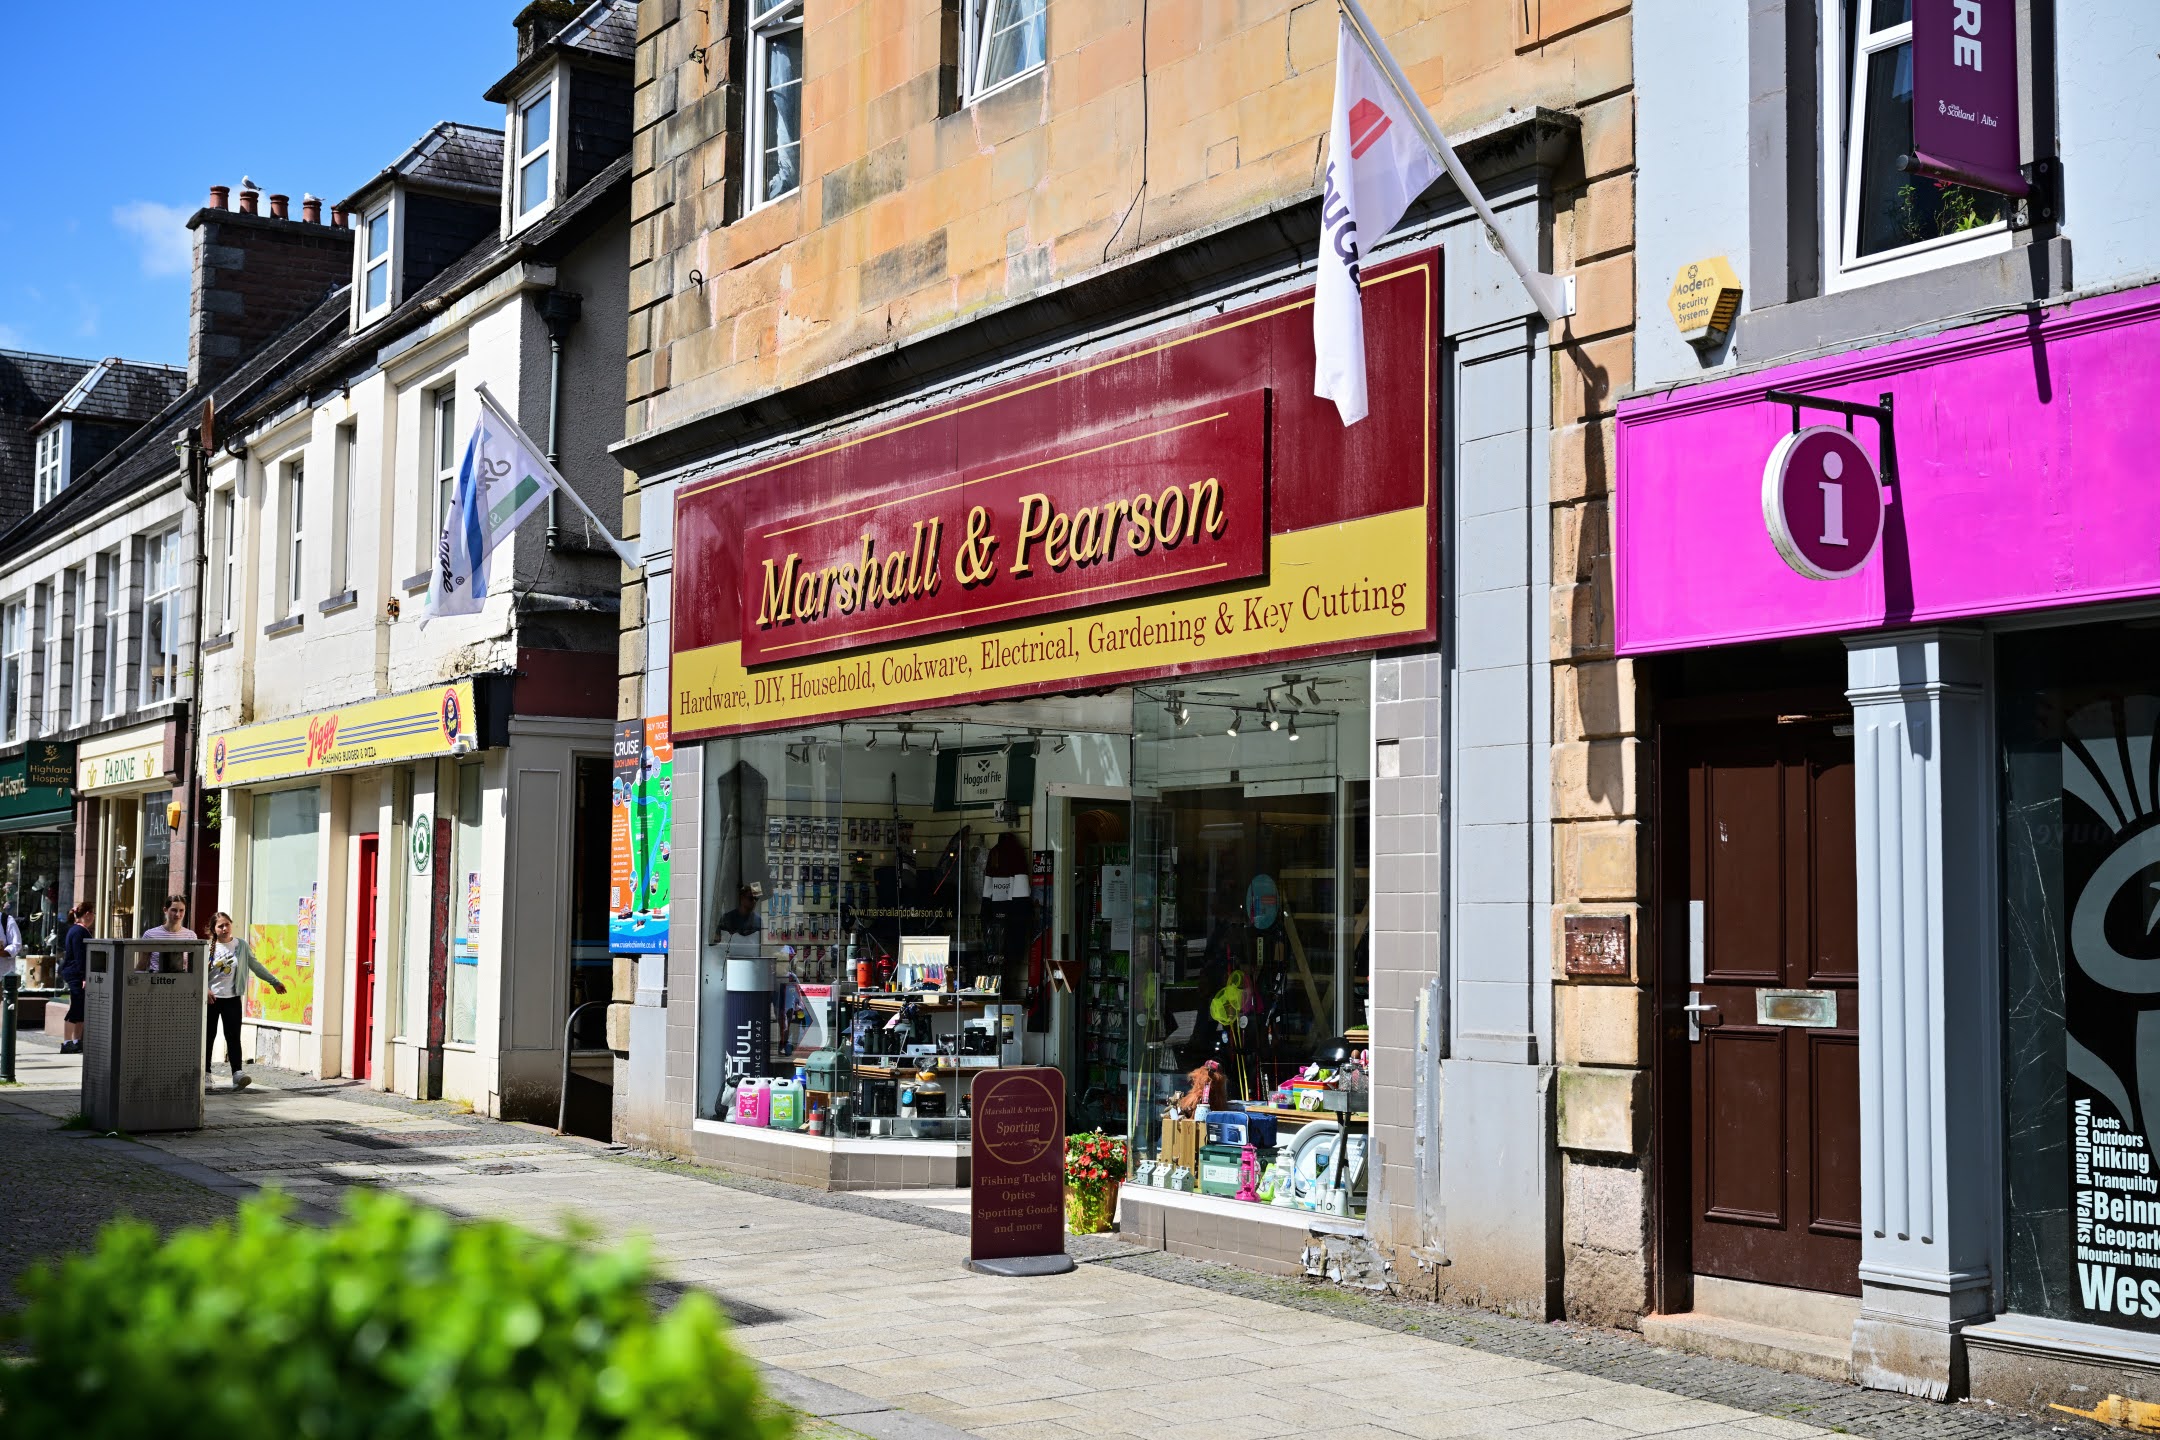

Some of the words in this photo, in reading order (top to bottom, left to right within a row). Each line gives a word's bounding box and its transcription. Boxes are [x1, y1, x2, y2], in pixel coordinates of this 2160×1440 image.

[1954, 0, 1982, 72] RE
[1947, 105, 1975, 121] Scotland
[1980, 114, 1997, 127] Alba
[1674, 277, 1714, 296] Modern
[1678, 296, 1708, 311] Security
[1679, 308, 1709, 324] Systems
[756, 517, 940, 627] Marshall
[955, 506, 996, 584] &
[1010, 477, 1224, 573] Pearson
[680, 687, 750, 715] Hardware,
[754, 675, 785, 706] DIY,
[790, 660, 875, 700] Household,
[882, 653, 972, 686] Cookware,
[981, 627, 1080, 671] Electrical,
[1088, 611, 1207, 654] Gardening
[1215, 602, 1234, 636] &
[1243, 596, 1294, 633] Key
[1302, 577, 1407, 621] Cutting
[655, 720, 668, 730] TICKE
[615, 739, 639, 756] CRUISE
[30, 765, 72, 775] Highland
[104, 757, 136, 784] FARINE
[963, 773, 983, 787] Hoggs
[984, 773, 991, 783] of
[991, 770, 1002, 783] Fife
[32, 774, 69, 785] Hospice
[150, 812, 170, 836] FARI
[151, 976, 176, 985] Litter
[984, 1107, 1016, 1115] Marshall
[1018, 1106, 1023, 1114] &
[1025, 1105, 1053, 1113] Pearson
[996, 1121, 1040, 1136] Sporting
[2092, 1115, 2120, 1130] Lochs
[2075, 1098, 2092, 1185] Woodland
[2092, 1129, 2144, 1147] Outdoors
[2092, 1145, 2150, 1174] Hiking
[981, 1176, 1020, 1186] Fishing
[1022, 1172, 1057, 1183] Tackle
[2093, 1171, 2158, 1194] Tranquility
[1002, 1190, 1036, 1202] Optics
[978, 1207, 1024, 1219] Sporting
[1026, 1204, 1058, 1215] Goods
[2077, 1190, 2093, 1244] Walks
[994, 1223, 1014, 1233] and
[1016, 1223, 1043, 1232] more
[2077, 1245, 2131, 1266] Mountain
[2077, 1262, 2160, 1319] Wes
